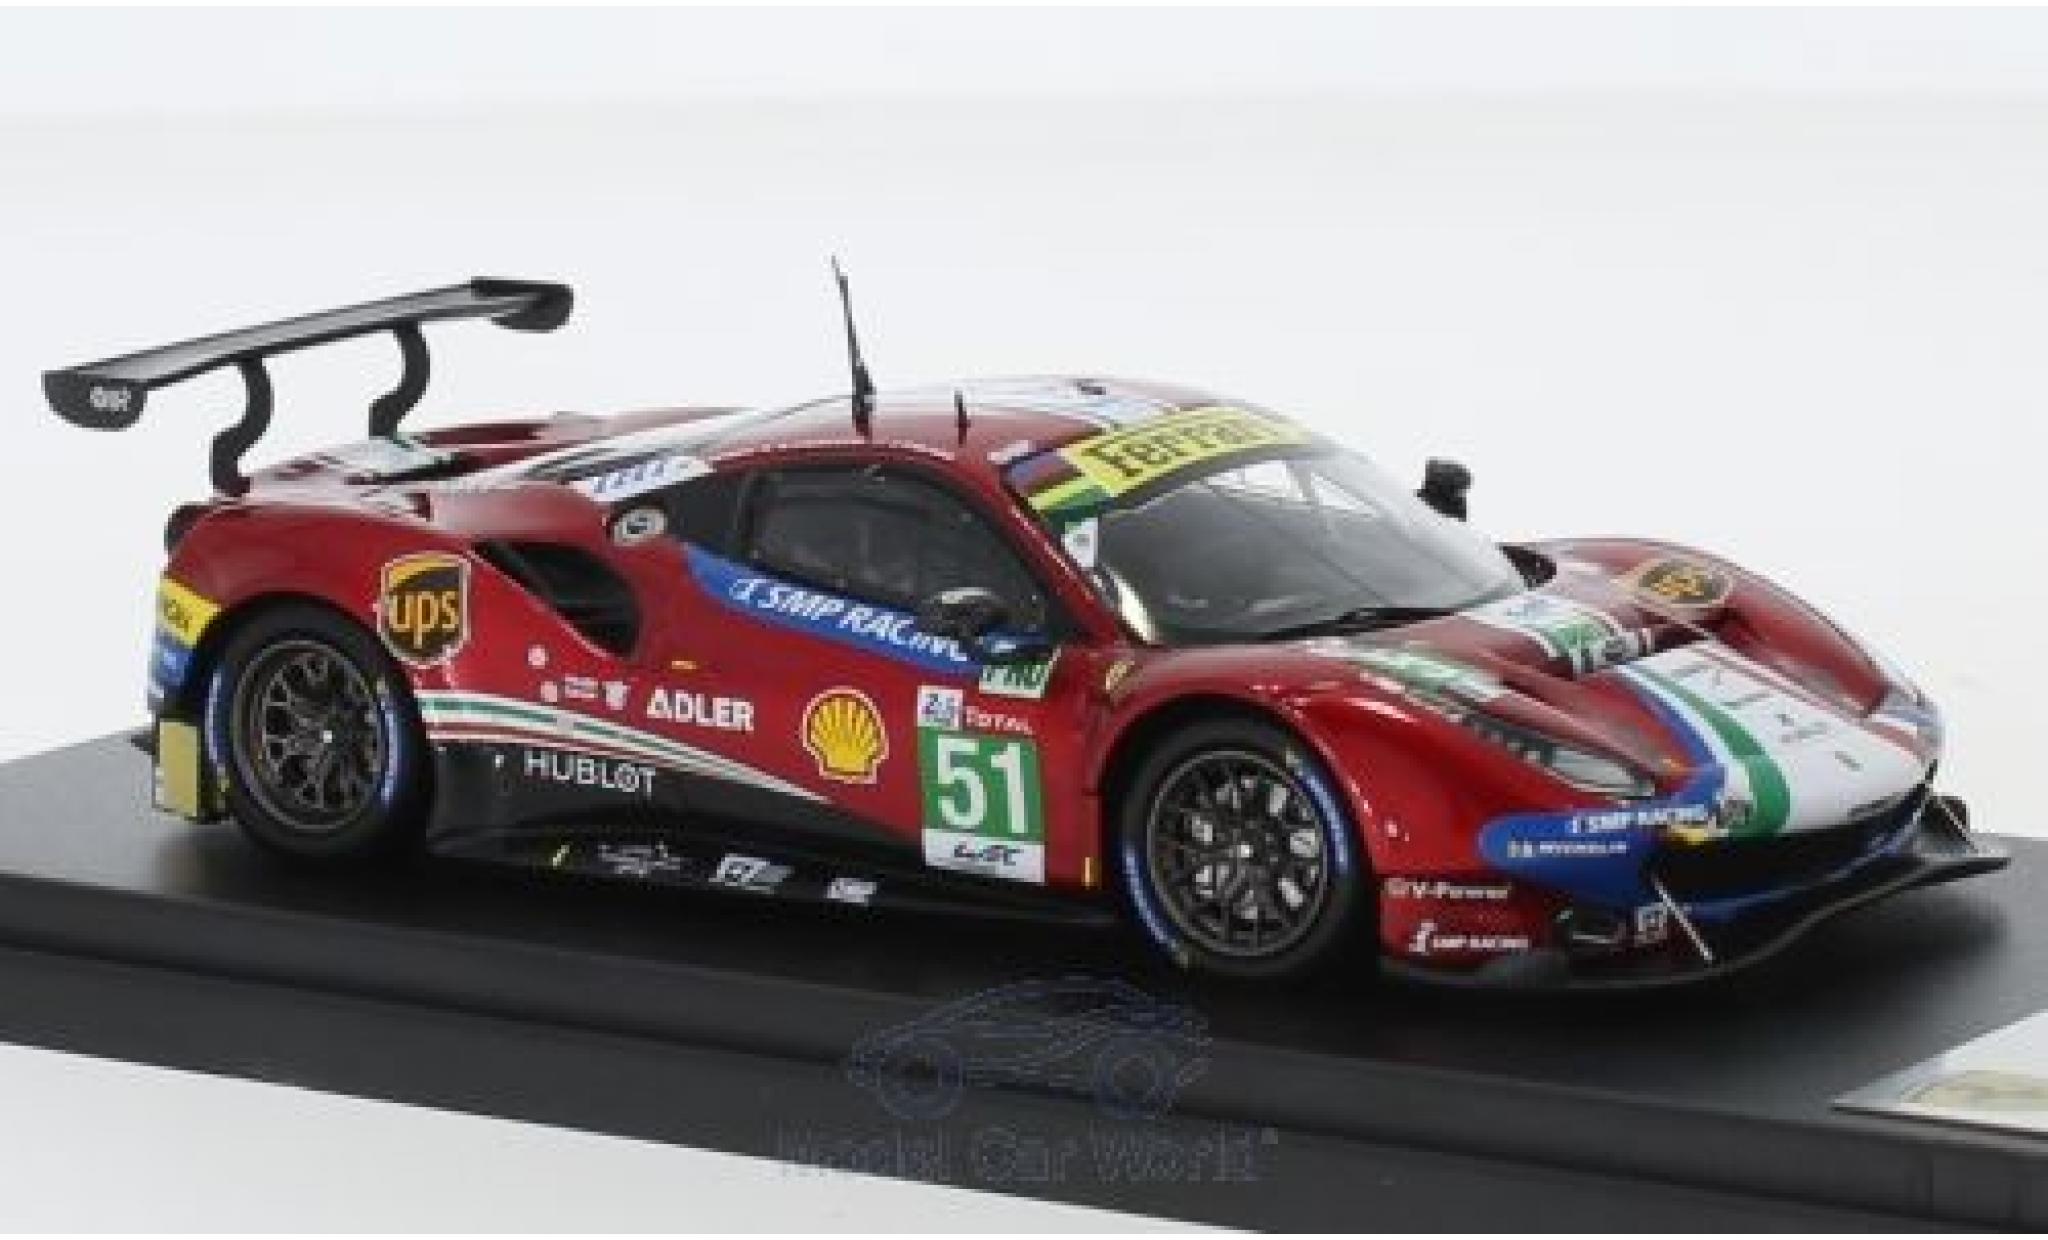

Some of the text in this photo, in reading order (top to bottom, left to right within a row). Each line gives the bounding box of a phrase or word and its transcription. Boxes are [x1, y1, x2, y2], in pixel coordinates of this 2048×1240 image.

[388, 590, 459, 648] ups
[646, 688, 755, 732] ADLER
[523, 751, 657, 793] HUBLOT
[936, 736, 1029, 834] 51
